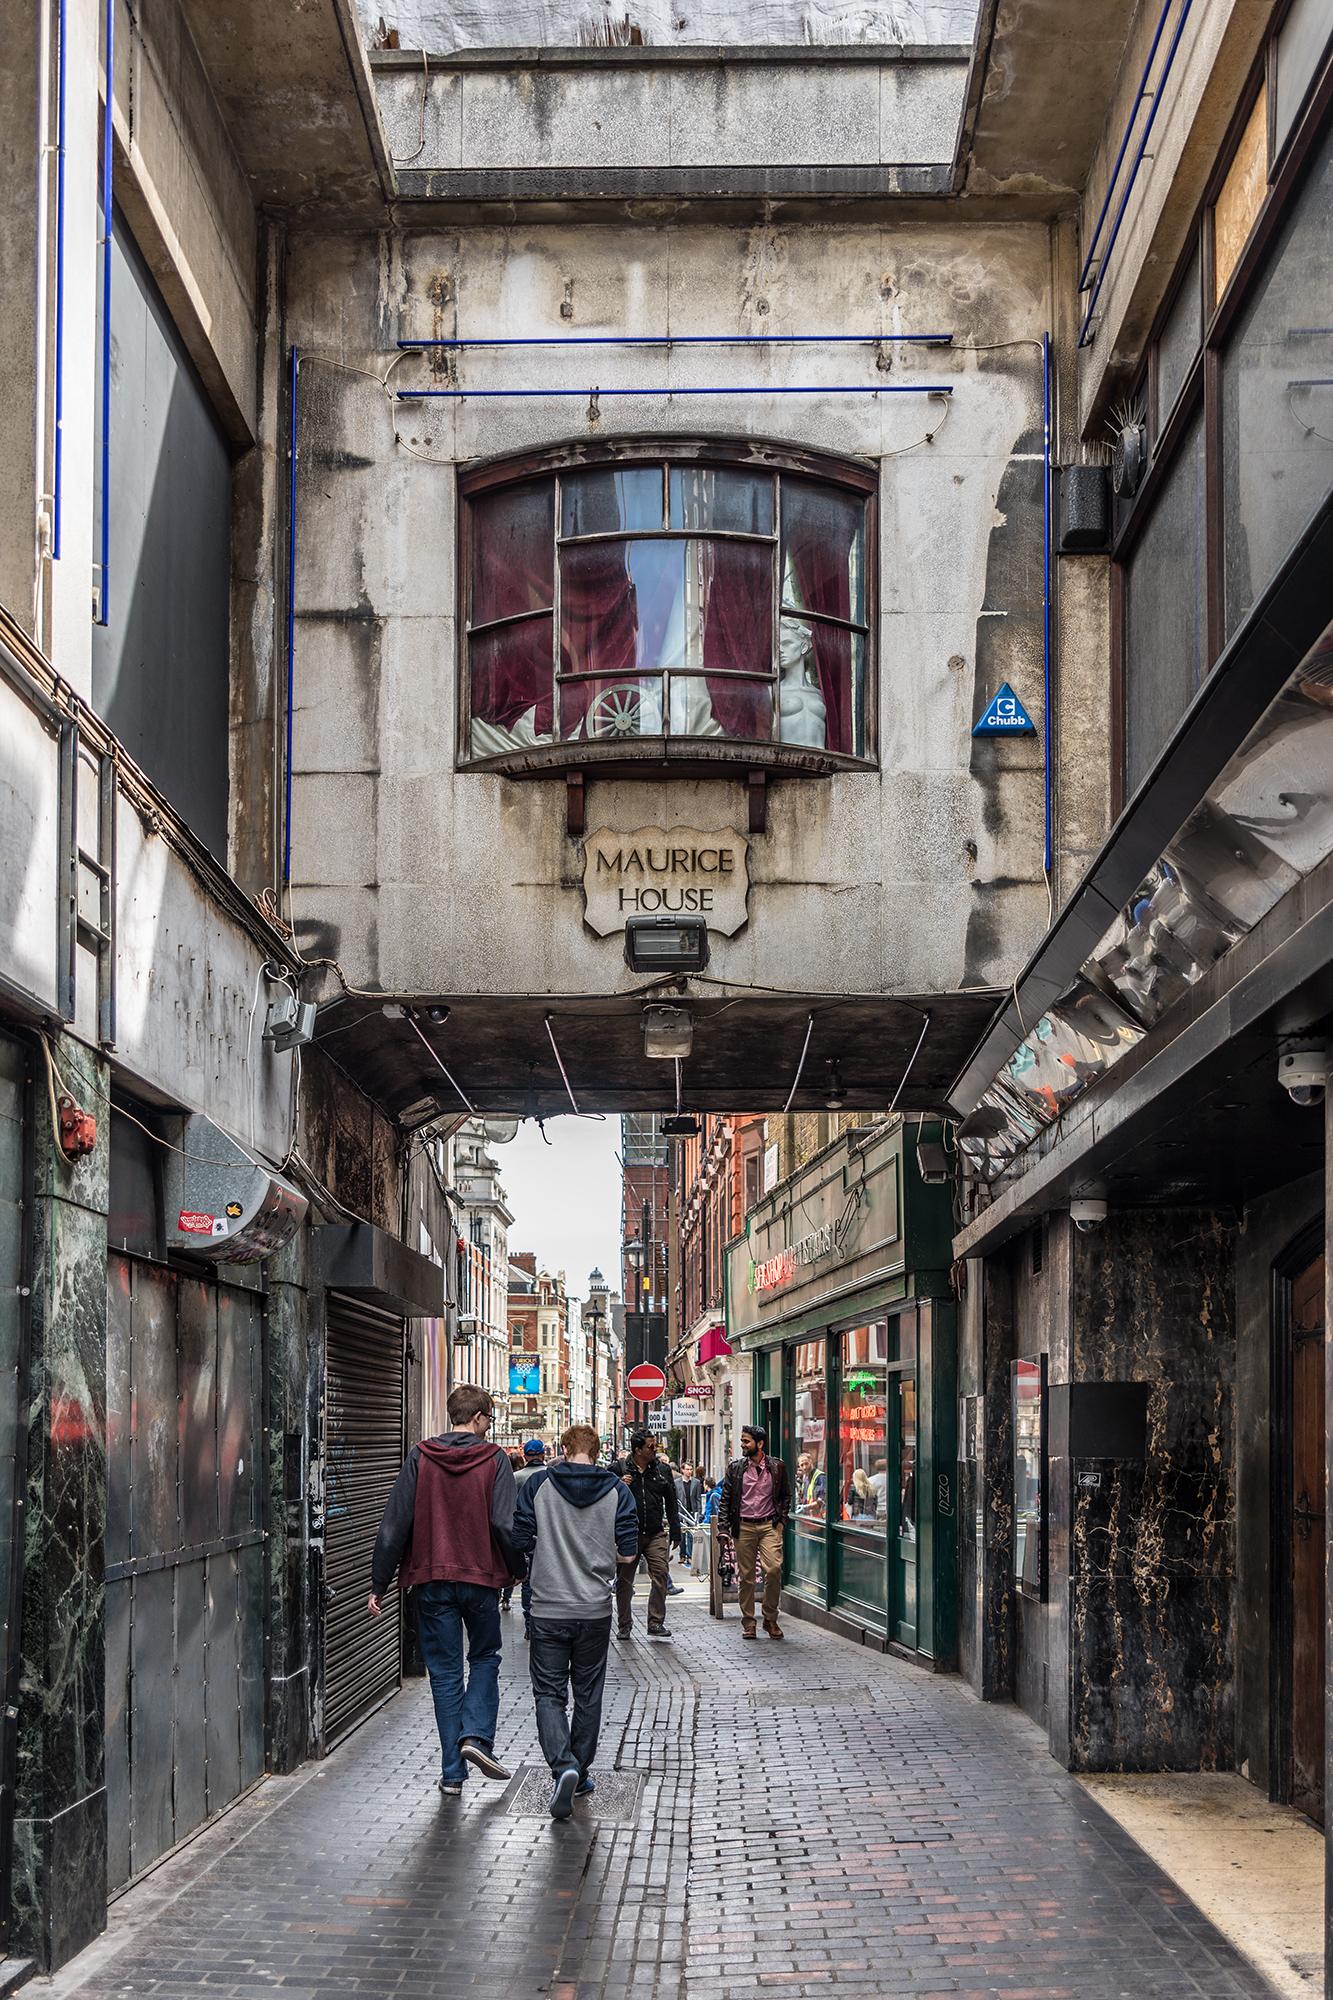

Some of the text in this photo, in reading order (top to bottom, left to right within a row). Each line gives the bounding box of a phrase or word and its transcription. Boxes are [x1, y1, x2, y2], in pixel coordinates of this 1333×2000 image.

[987, 715, 1026, 726] Chubb
[596, 849, 734, 873] MAURICE
[618, 888, 714, 911] HOUSE
